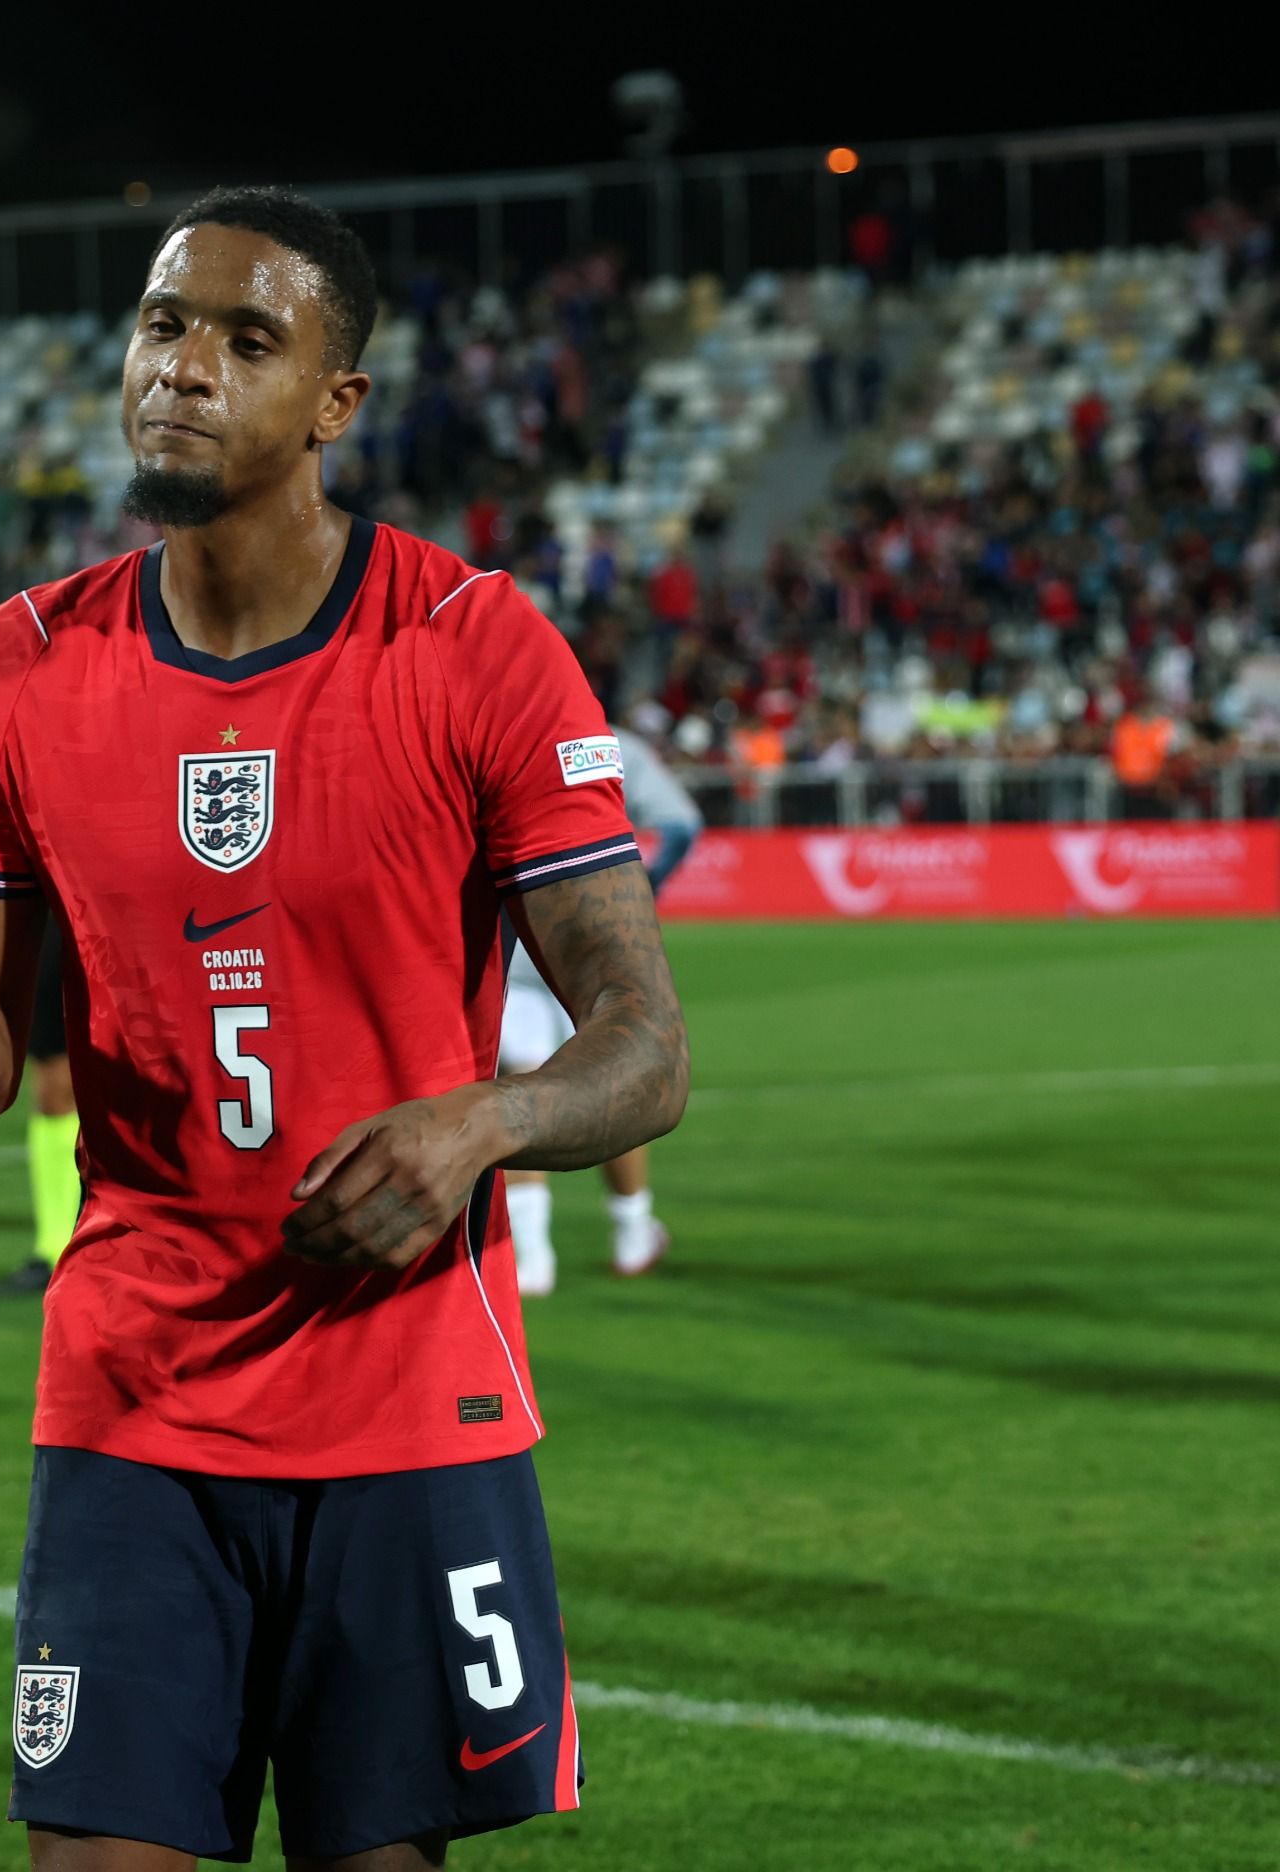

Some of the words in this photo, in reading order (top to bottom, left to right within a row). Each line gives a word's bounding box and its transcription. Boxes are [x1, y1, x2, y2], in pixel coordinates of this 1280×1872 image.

[561, 742, 584, 755] UEFA
[202, 948, 265, 969] CROATIA
[209, 970, 263, 991] 03.10.26
[212, 1004, 275, 1150] 5
[445, 1557, 525, 1711] 5
